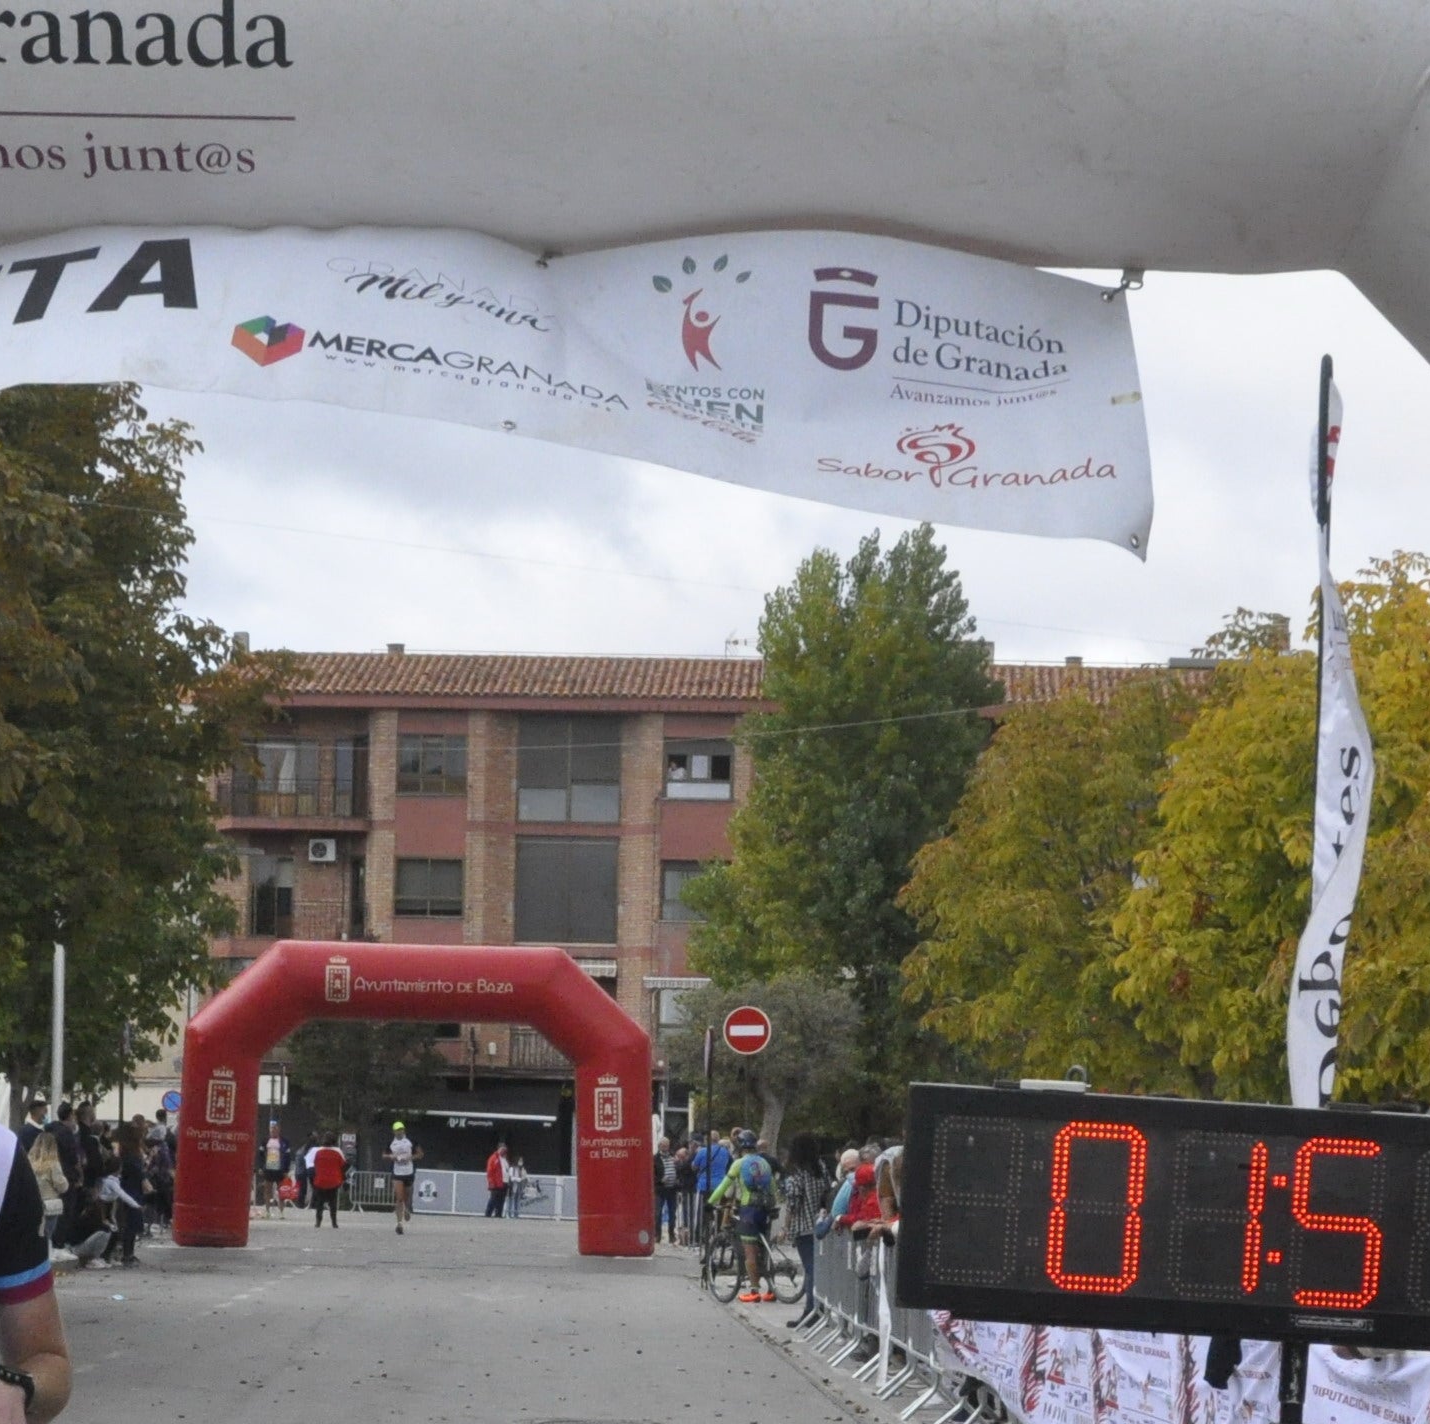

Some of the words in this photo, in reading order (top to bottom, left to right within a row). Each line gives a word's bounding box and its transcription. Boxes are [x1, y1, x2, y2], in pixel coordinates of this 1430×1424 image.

[81, 131, 256, 178] junt@s
[894, 298, 1066, 355] Diputación
[308, 330, 631, 411] MERCAGRANADA
[892, 336, 929, 367] de
[935, 343, 1068, 382] Granada
[727, 387, 765, 401] CON
[890, 383, 991, 408] Avanzamos
[817, 457, 923, 483] Sabor
[947, 457, 1118, 488] Granada
